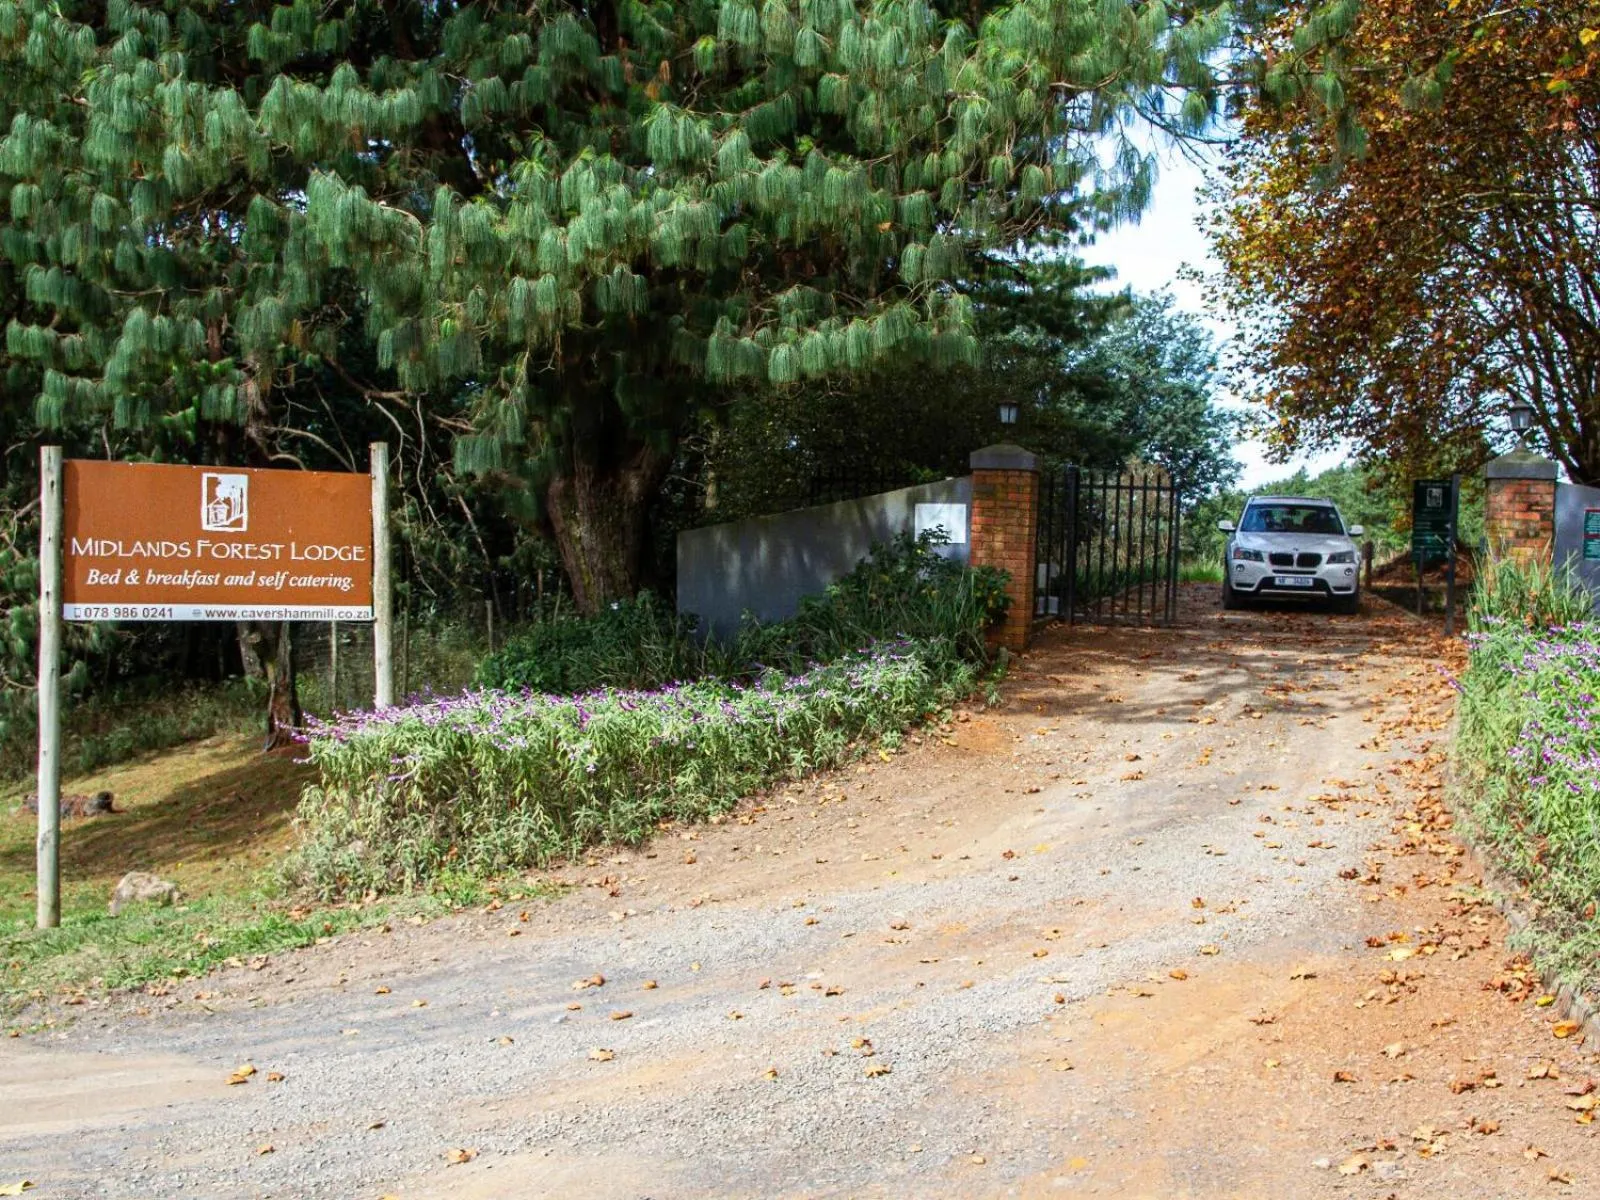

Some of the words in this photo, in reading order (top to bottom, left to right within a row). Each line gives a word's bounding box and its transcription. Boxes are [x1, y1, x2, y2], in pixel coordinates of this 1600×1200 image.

[71, 537, 191, 558] MIDLANDS
[196, 539, 285, 560] FOREST
[290, 541, 366, 562] LODGE
[86, 568, 121, 585] Bed
[124, 568, 140, 585] &
[146, 569, 221, 589] breakfast
[223, 571, 256, 587] and
[257, 571, 289, 590] self
[288, 573, 355, 592] catering.
[84, 607, 109, 618] 078
[113, 607, 138, 618] 986
[142, 607, 173, 618] 0241
[205, 608, 370, 619] www.cavershammill.co.za
